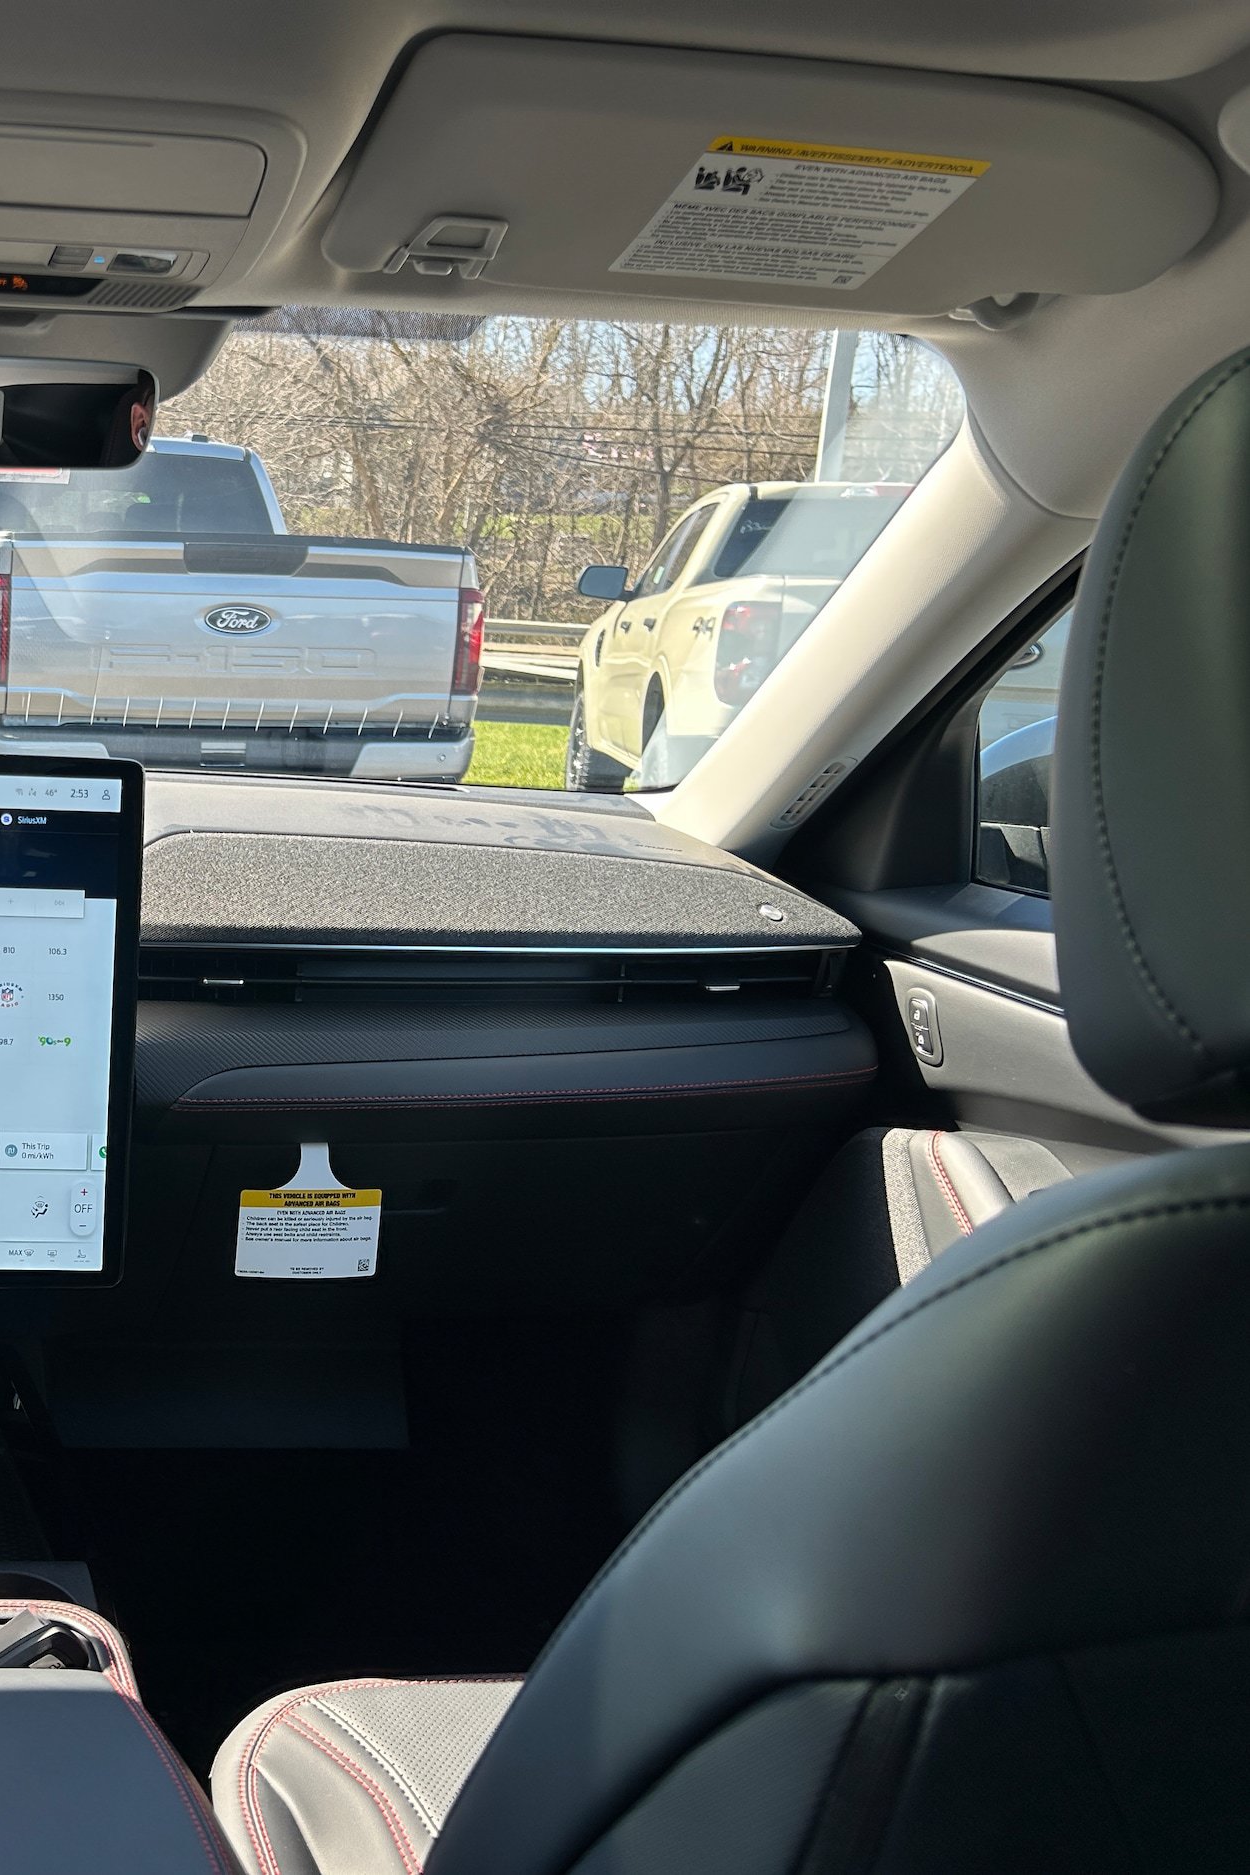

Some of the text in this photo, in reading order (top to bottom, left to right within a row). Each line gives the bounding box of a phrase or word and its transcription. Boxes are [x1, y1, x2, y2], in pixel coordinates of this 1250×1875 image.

[740, 144, 792, 156] WARNING
[217, 608, 258, 631] Ford
[70, 788, 89, 799] 2:53
[17, 815, 47, 825] SiriusXM
[2, 946, 16, 954] 810
[48, 947, 67, 956] 106.3
[48, 993, 65, 1001] 1350
[21, 1142, 50, 1151] This Trip
[283, 1192, 306, 1200] VEHICLE
[307, 1192, 313, 1200] IS
[314, 1192, 340, 1200] EQUIPPED
[342, 1191, 356, 1199] WITH
[74, 1203, 93, 1214] OFF
[284, 1200, 313, 1208] ADVANCED
[314, 1200, 325, 1208] AIR
[8, 1249, 23, 1257] MAX
